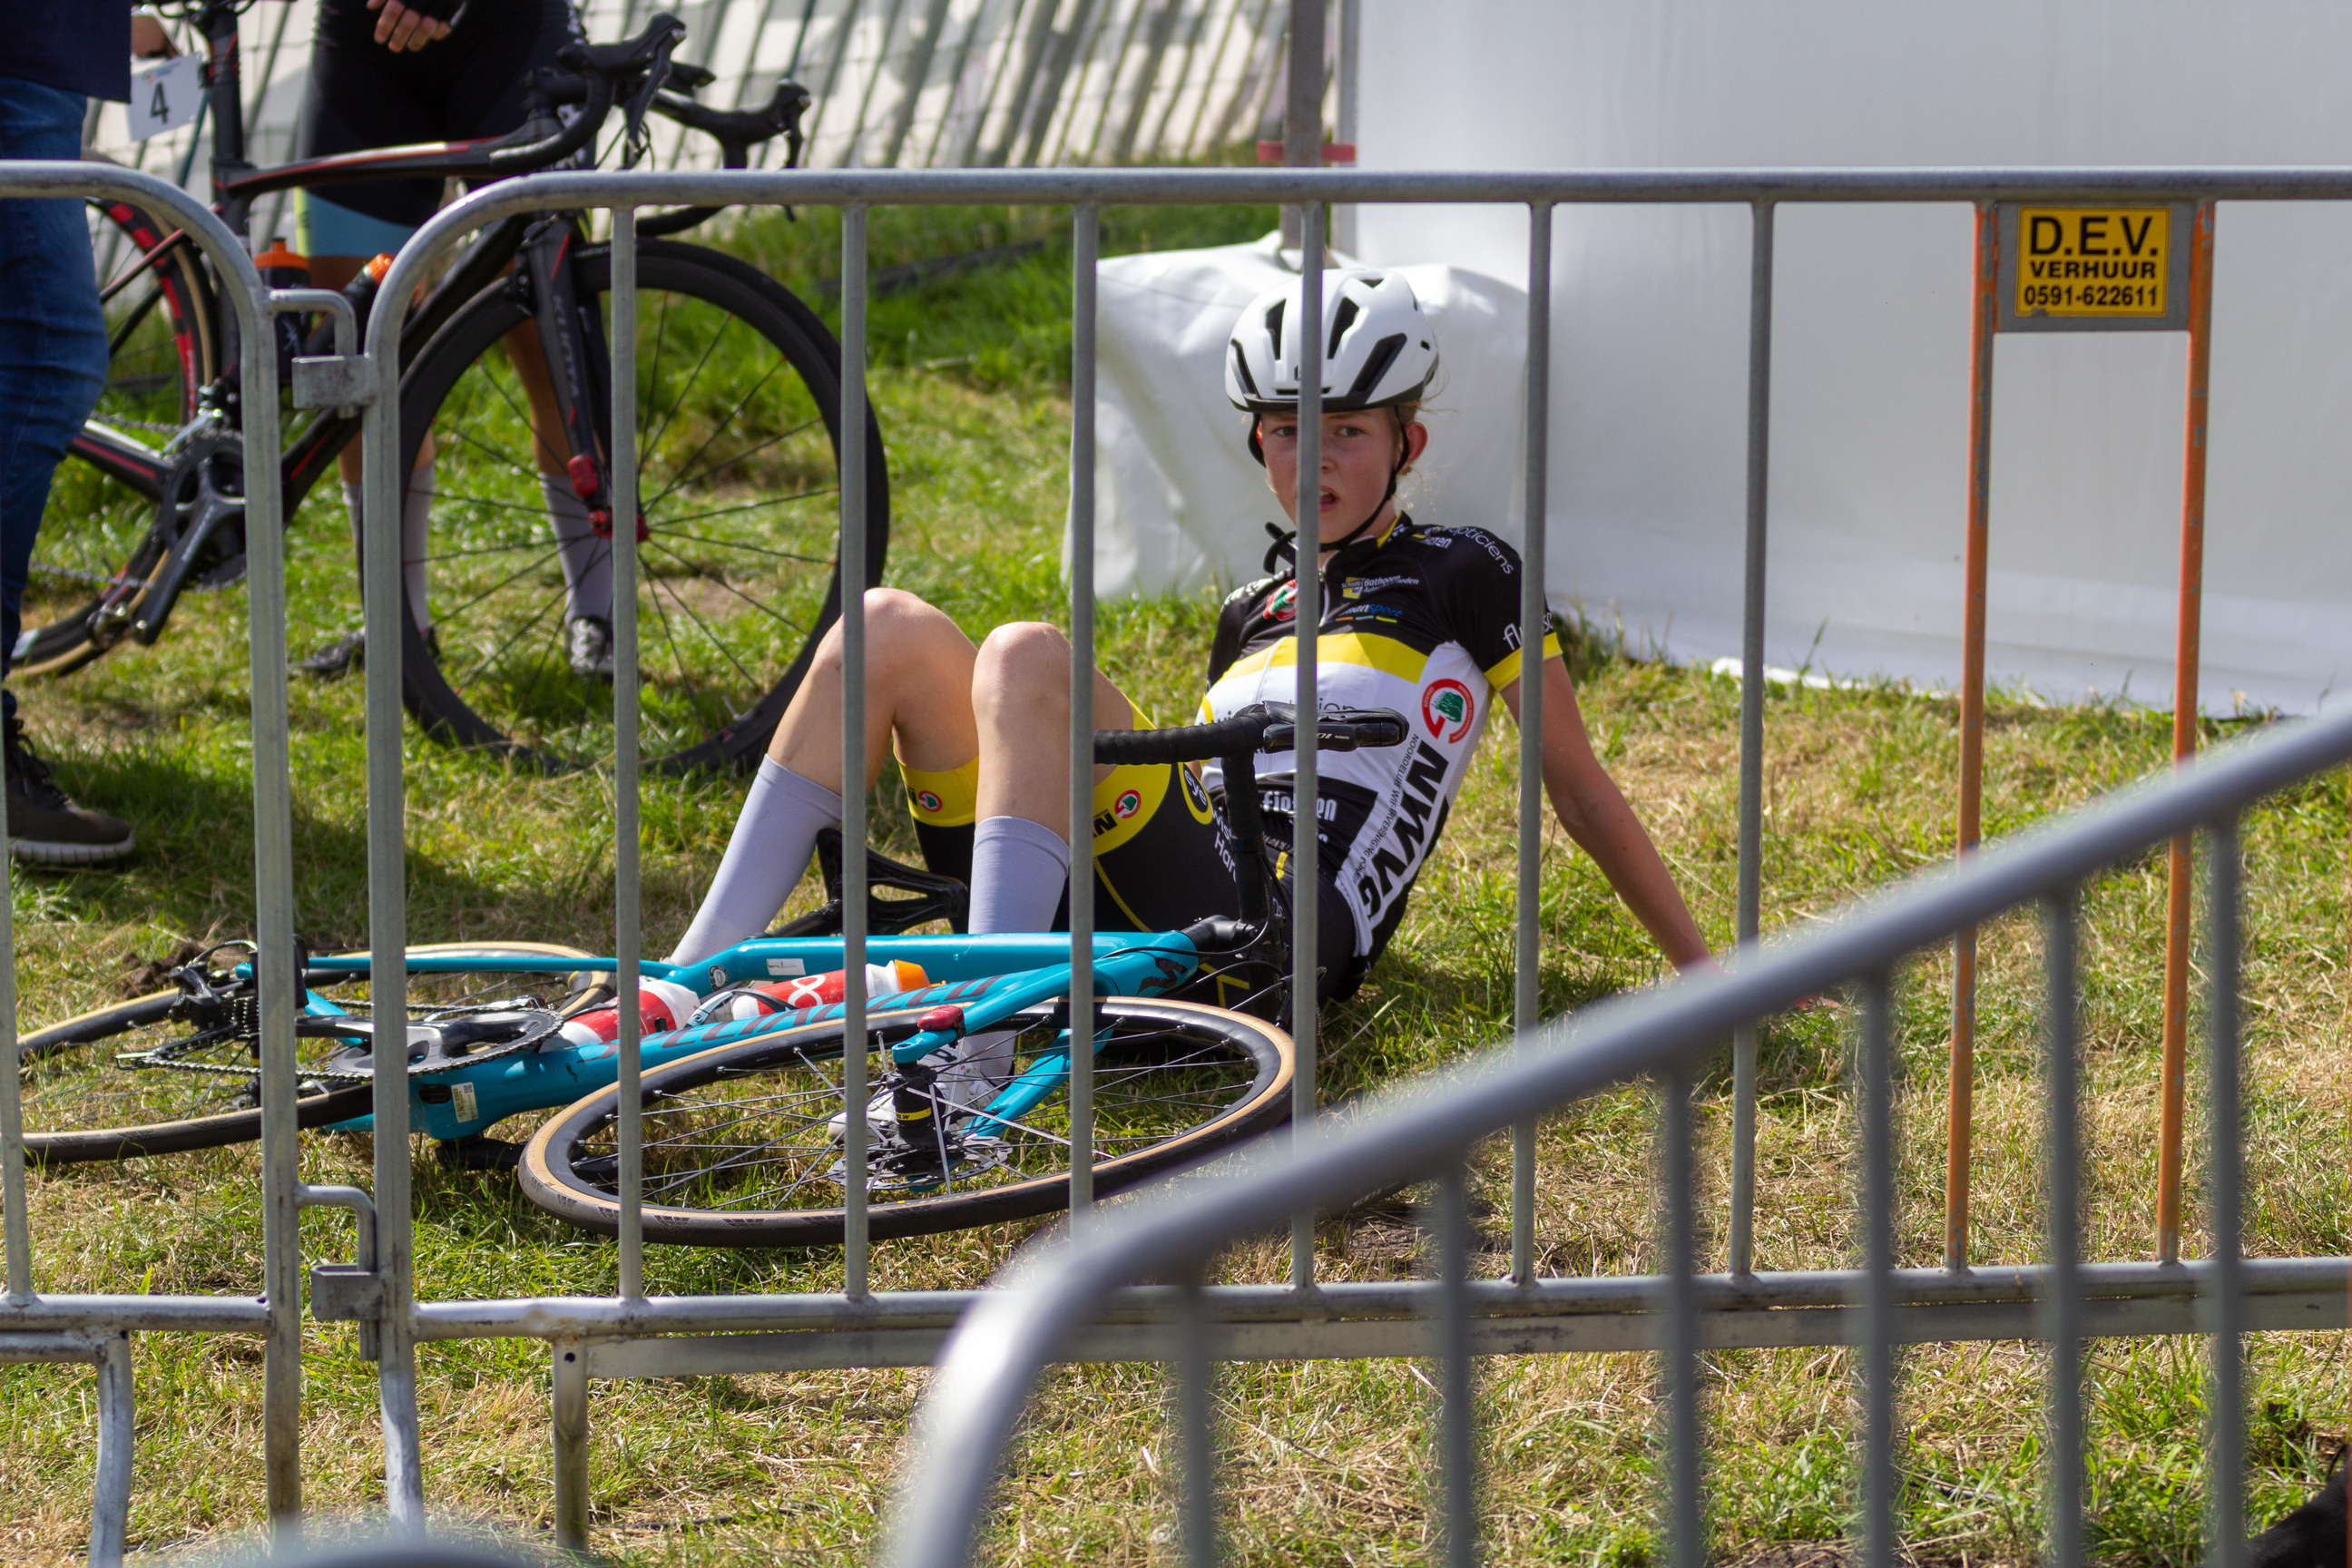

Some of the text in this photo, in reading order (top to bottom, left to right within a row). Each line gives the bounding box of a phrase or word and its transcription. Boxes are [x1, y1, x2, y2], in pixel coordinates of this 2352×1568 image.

[150, 81, 169, 124] 4
[2030, 216, 2159, 256] D.E.V.
[2029, 260, 2156, 279] VERHUUR
[1184, 769, 1208, 806] eye
[1262, 790, 1338, 821] fieen
[1357, 740, 1449, 921] NWVG
